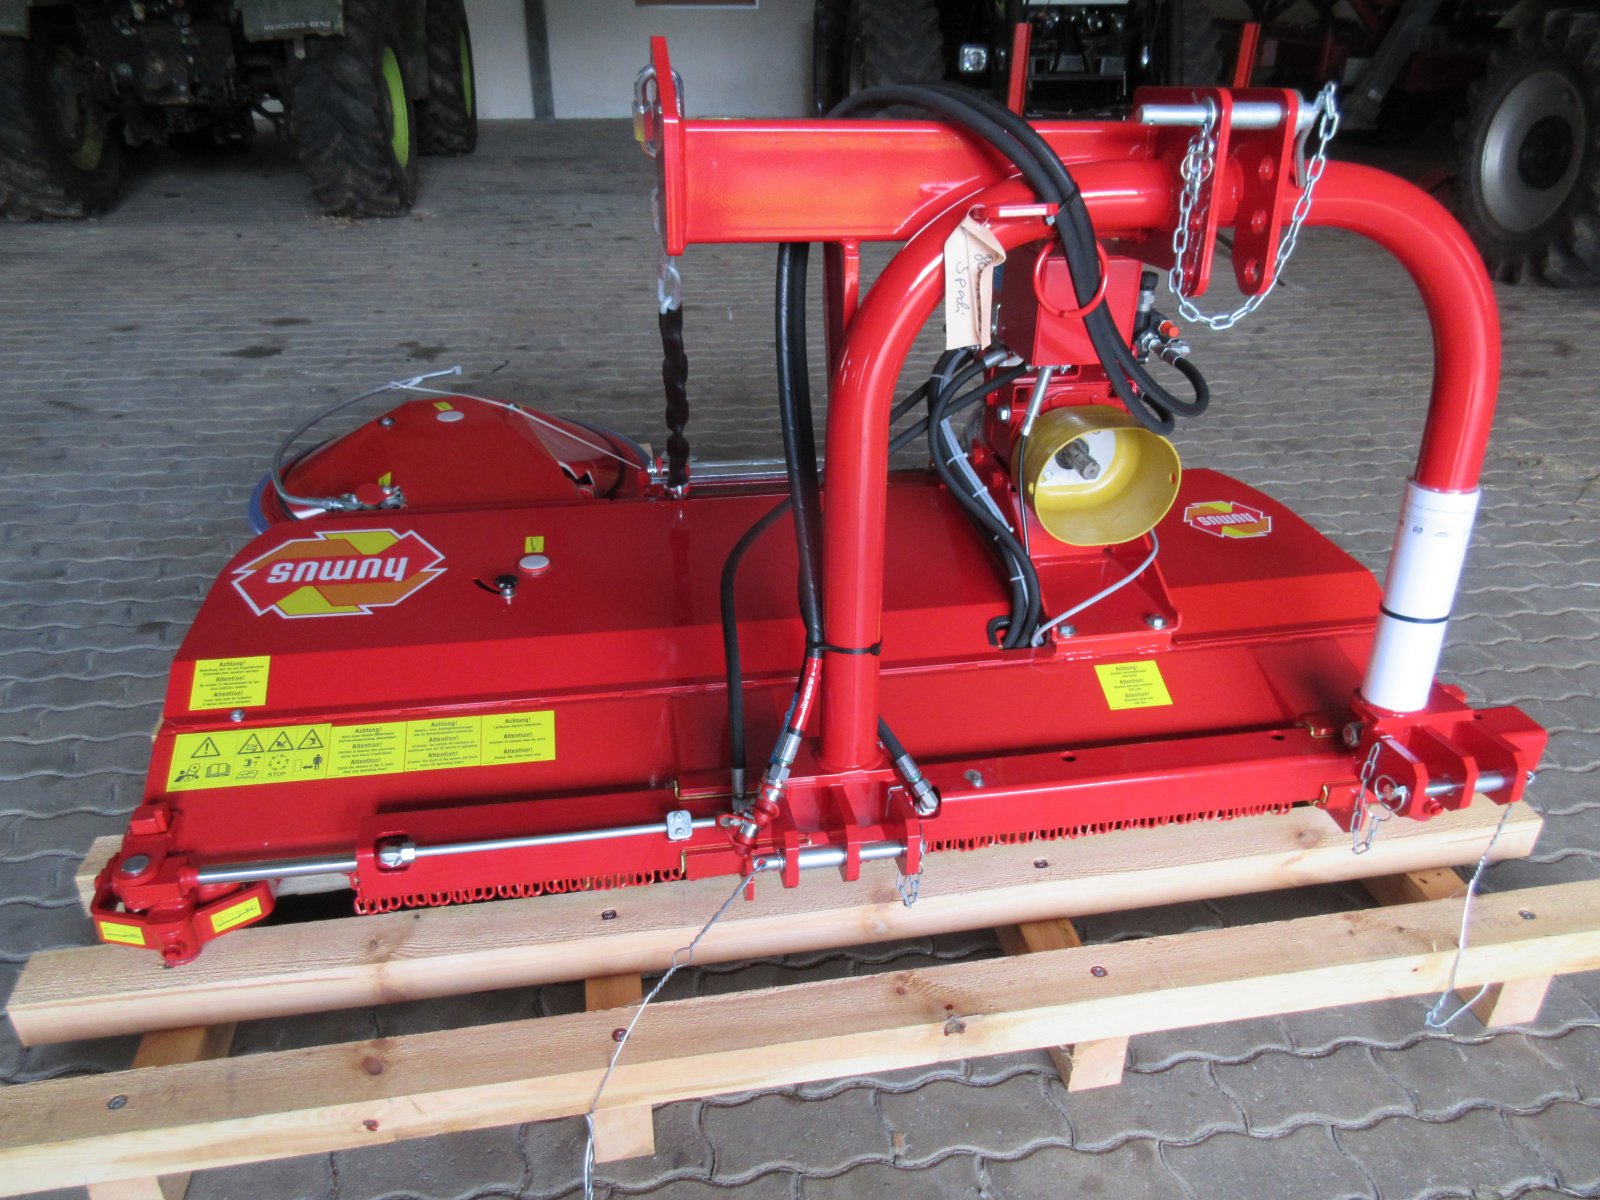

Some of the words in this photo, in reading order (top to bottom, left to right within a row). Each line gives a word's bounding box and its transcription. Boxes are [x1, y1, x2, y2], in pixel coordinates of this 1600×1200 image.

[1196, 512, 1258, 526] humus
[266, 556, 409, 584] humus
[354, 726, 382, 734] Achtung!
[428, 735, 459, 743] Attention!
[352, 741, 382, 749] Attention!
[350, 757, 382, 765] Attention!
